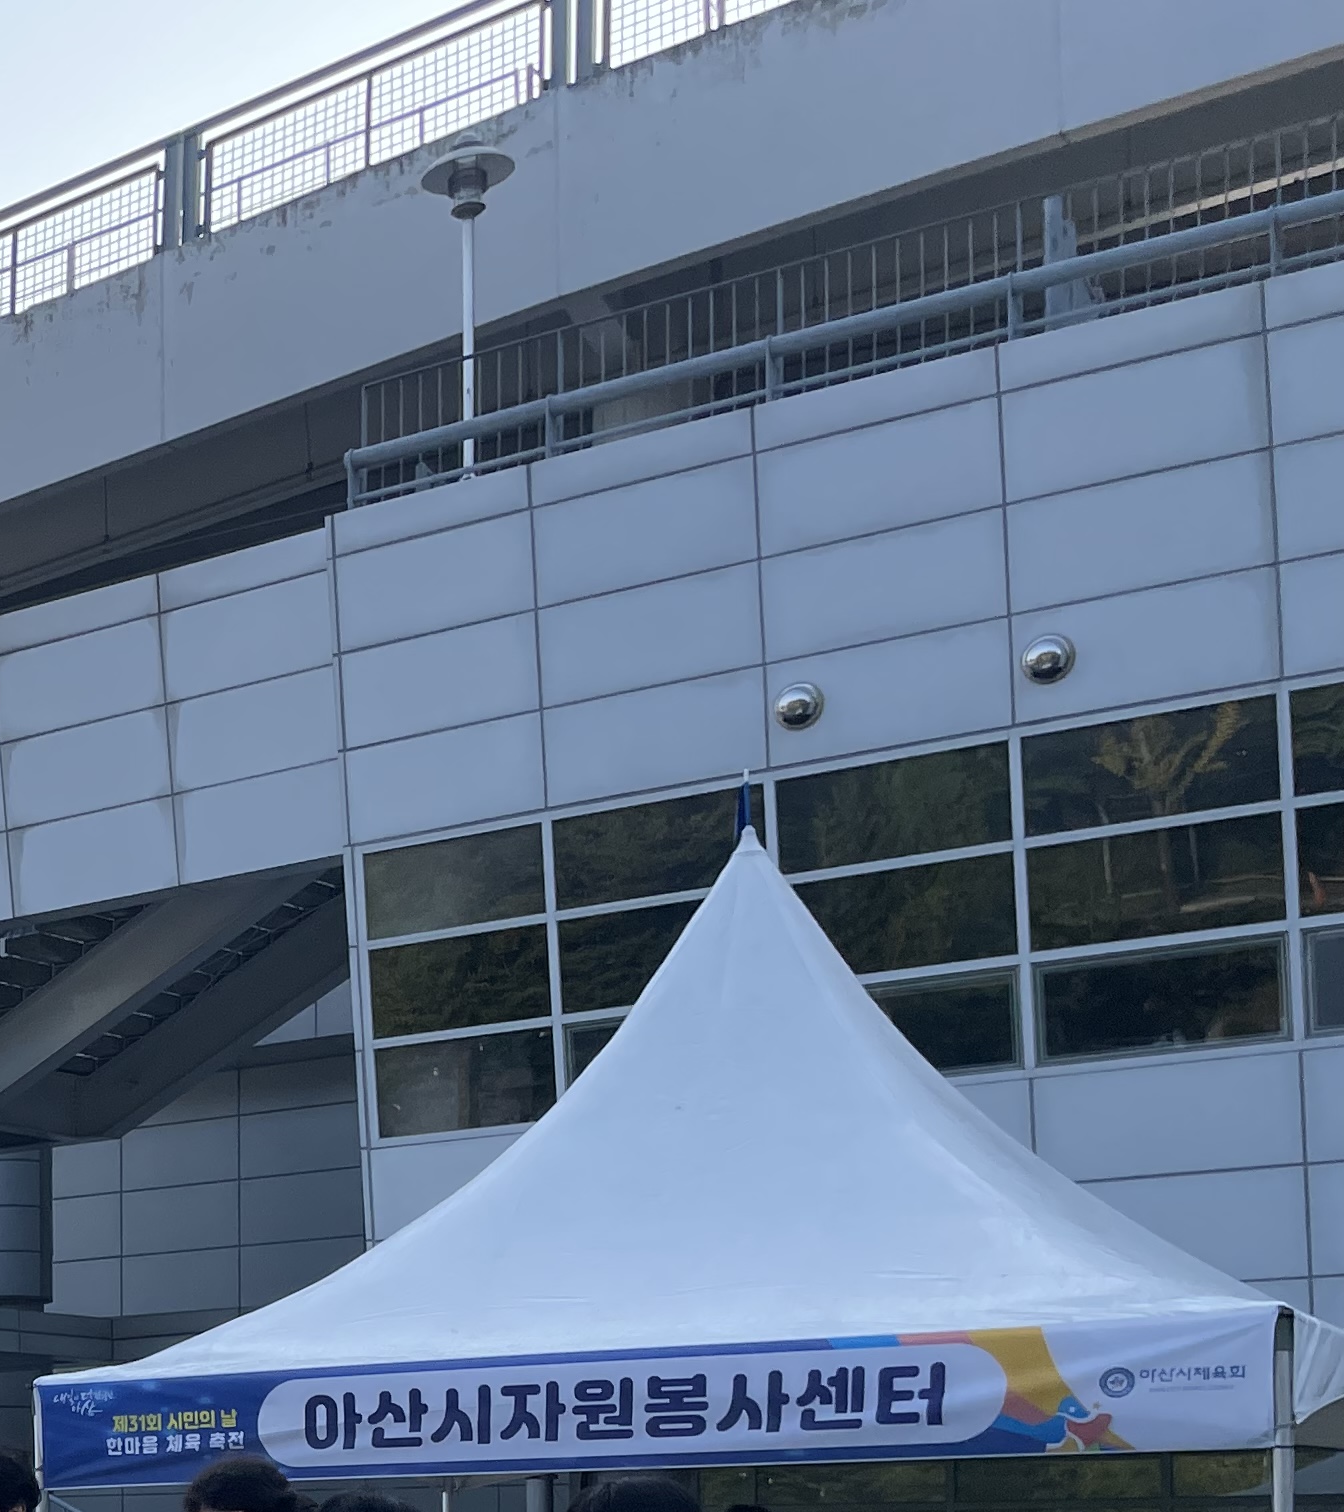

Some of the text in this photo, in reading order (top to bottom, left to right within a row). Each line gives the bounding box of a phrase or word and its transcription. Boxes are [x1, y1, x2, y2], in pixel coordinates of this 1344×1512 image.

[1139, 1364, 1247, 1383] 아산시체육회
[304, 1361, 946, 1450] 아산시자원봉사센터
[112, 1408, 238, 1433] 제31회 시민의 날
[106, 1430, 245, 1456] 한마음 체육 축전
